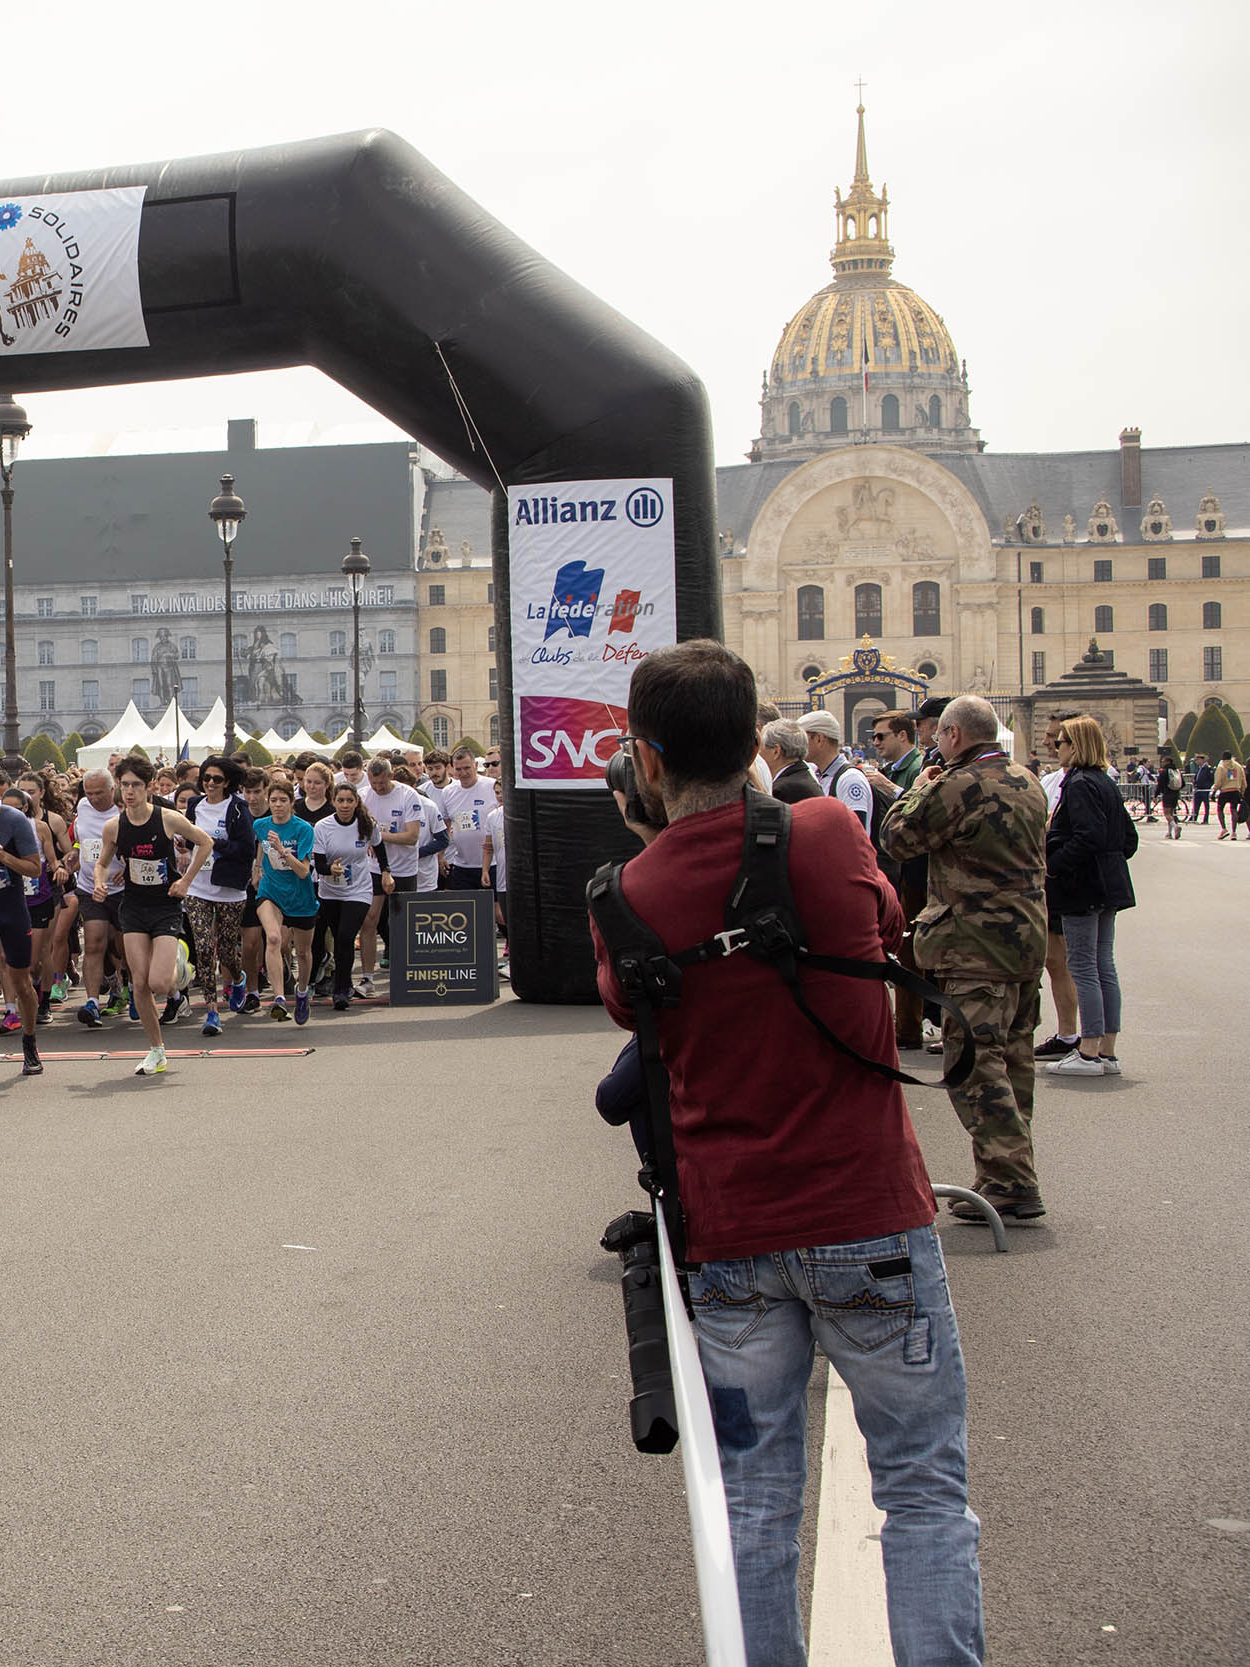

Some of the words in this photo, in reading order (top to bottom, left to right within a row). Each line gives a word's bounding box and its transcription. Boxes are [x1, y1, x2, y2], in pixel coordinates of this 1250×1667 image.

[28, 206, 84, 338] SOLIDAIRES
[515, 496, 617, 526] Allianz
[141, 598, 166, 614] AUX
[236, 593, 282, 610] ENTREZ
[284, 590, 317, 609] DANS
[526, 602, 546, 620] La
[531, 646, 573, 665] Clubs
[602, 642, 649, 665] Défen
[525, 728, 628, 769] SNC
[414, 912, 468, 932] PRO
[415, 931, 468, 945] TIMING
